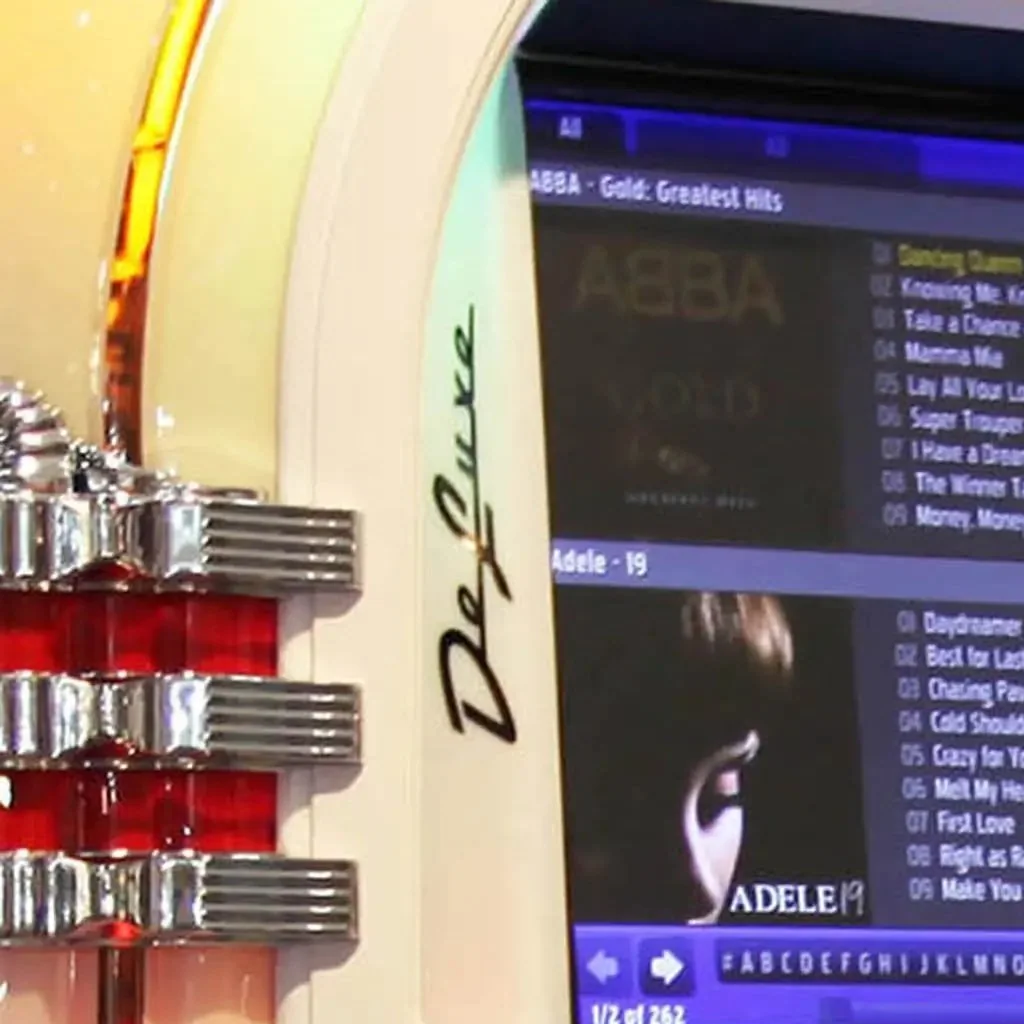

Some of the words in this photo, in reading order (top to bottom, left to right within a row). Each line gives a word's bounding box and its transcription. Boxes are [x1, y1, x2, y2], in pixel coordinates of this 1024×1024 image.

[529, 168, 582, 196] ABBA
[599, 174, 651, 202] Gold:
[655, 180, 740, 210] Greatest
[745, 187, 784, 213] Hits
[901, 276, 973, 311] Knowing
[904, 308, 944, 334] Take
[946, 315, 960, 335] a
[962, 313, 1022, 339] Chance
[904, 341, 971, 367] Mamma
[906, 375, 937, 402] Lay
[940, 376, 962, 398] All
[965, 377, 1001, 402] Your
[910, 405, 957, 435] Super
[920, 440, 964, 464] Have
[965, 446, 980, 465] a
[914, 470, 948, 496] The
[949, 473, 1008, 499] Winner
[551, 548, 607, 575] Adele
[625, 550, 649, 577] 19
[923, 611, 1023, 641] Daydreamer
[925, 644, 963, 669] Best
[966, 646, 990, 669] for
[928, 677, 994, 709] Chasing
[929, 710, 966, 735] Cold
[932, 744, 977, 774] Crazy
[980, 744, 1005, 769] for
[934, 777, 971, 802] Melt
[974, 778, 998, 807] My
[937, 811, 974, 836] First
[975, 811, 1016, 836] Love
[939, 844, 986, 875] Right
[987, 847, 1008, 870] as
[728, 883, 838, 915] ADELE
[941, 877, 986, 902] Make
[988, 878, 1022, 902] You
